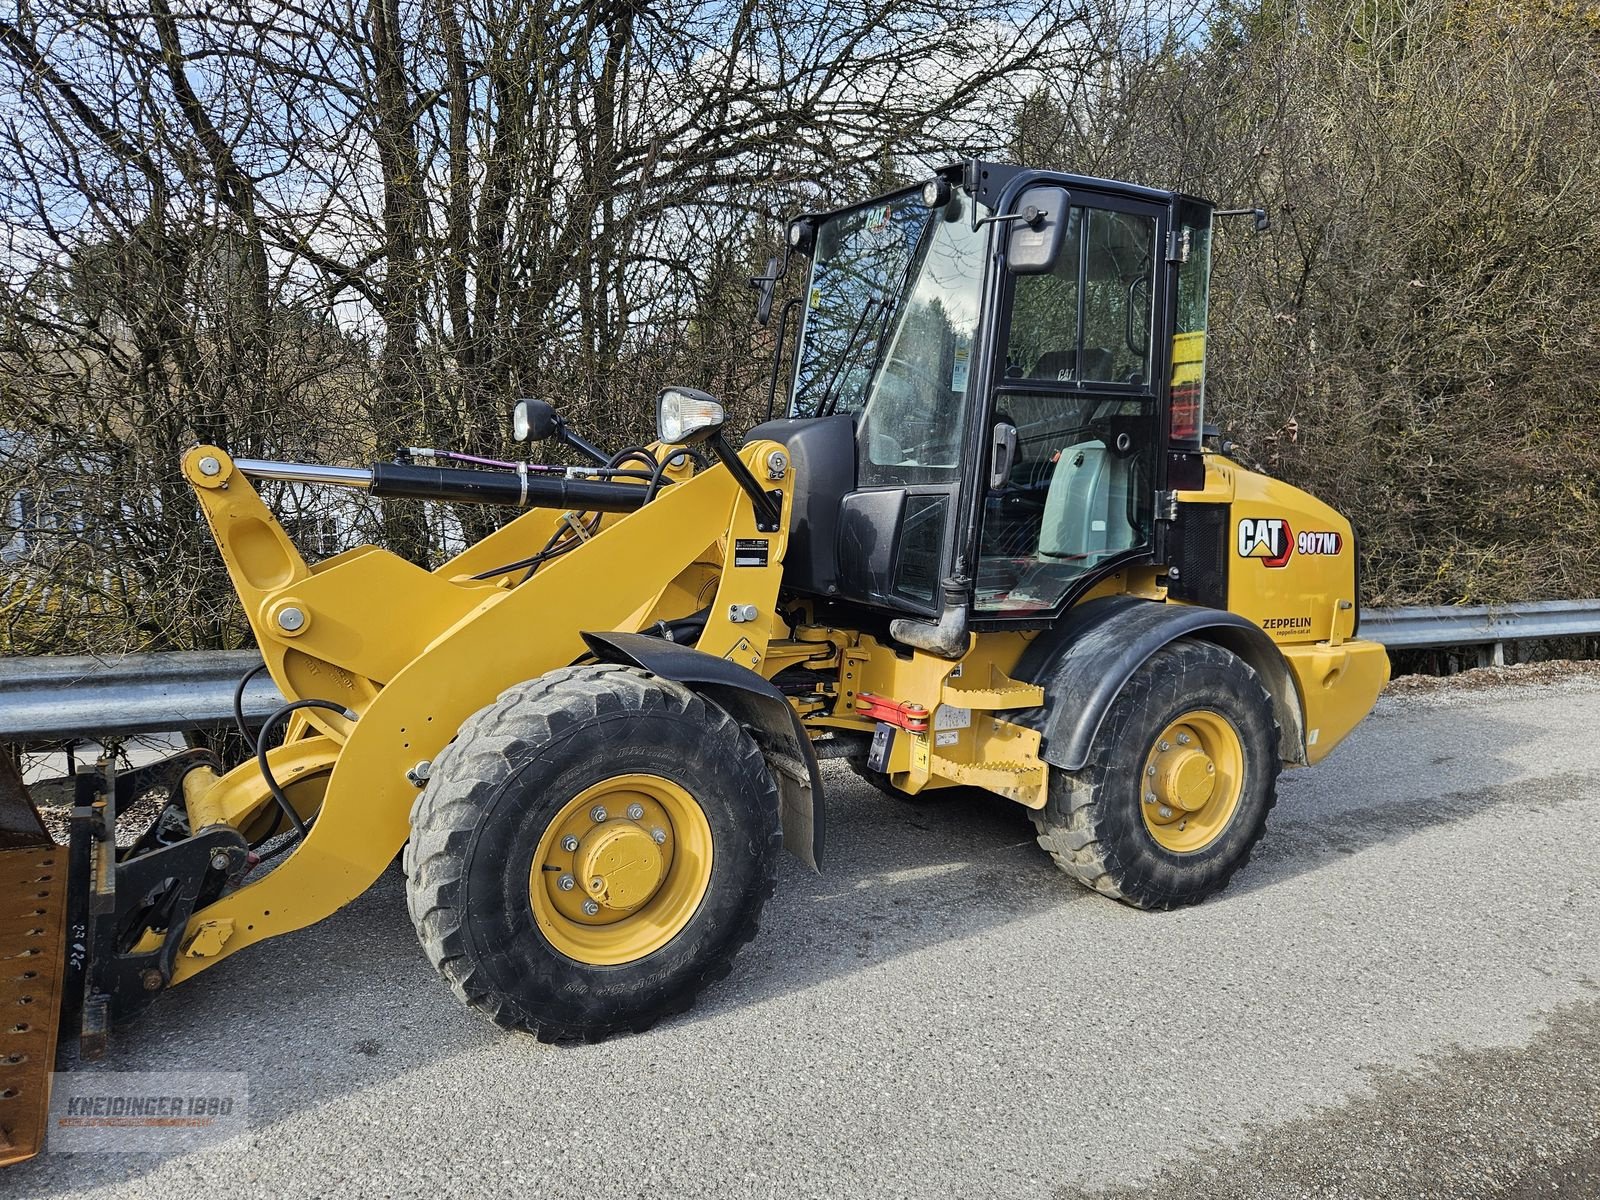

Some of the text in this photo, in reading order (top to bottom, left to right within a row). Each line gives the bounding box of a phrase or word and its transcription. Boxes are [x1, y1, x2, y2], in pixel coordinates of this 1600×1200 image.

[1057, 368, 1075, 381] CAT
[1238, 519, 1283, 557] CAT
[1298, 532, 1336, 554] 907M
[1262, 617, 1311, 629] ZEPPELIN
